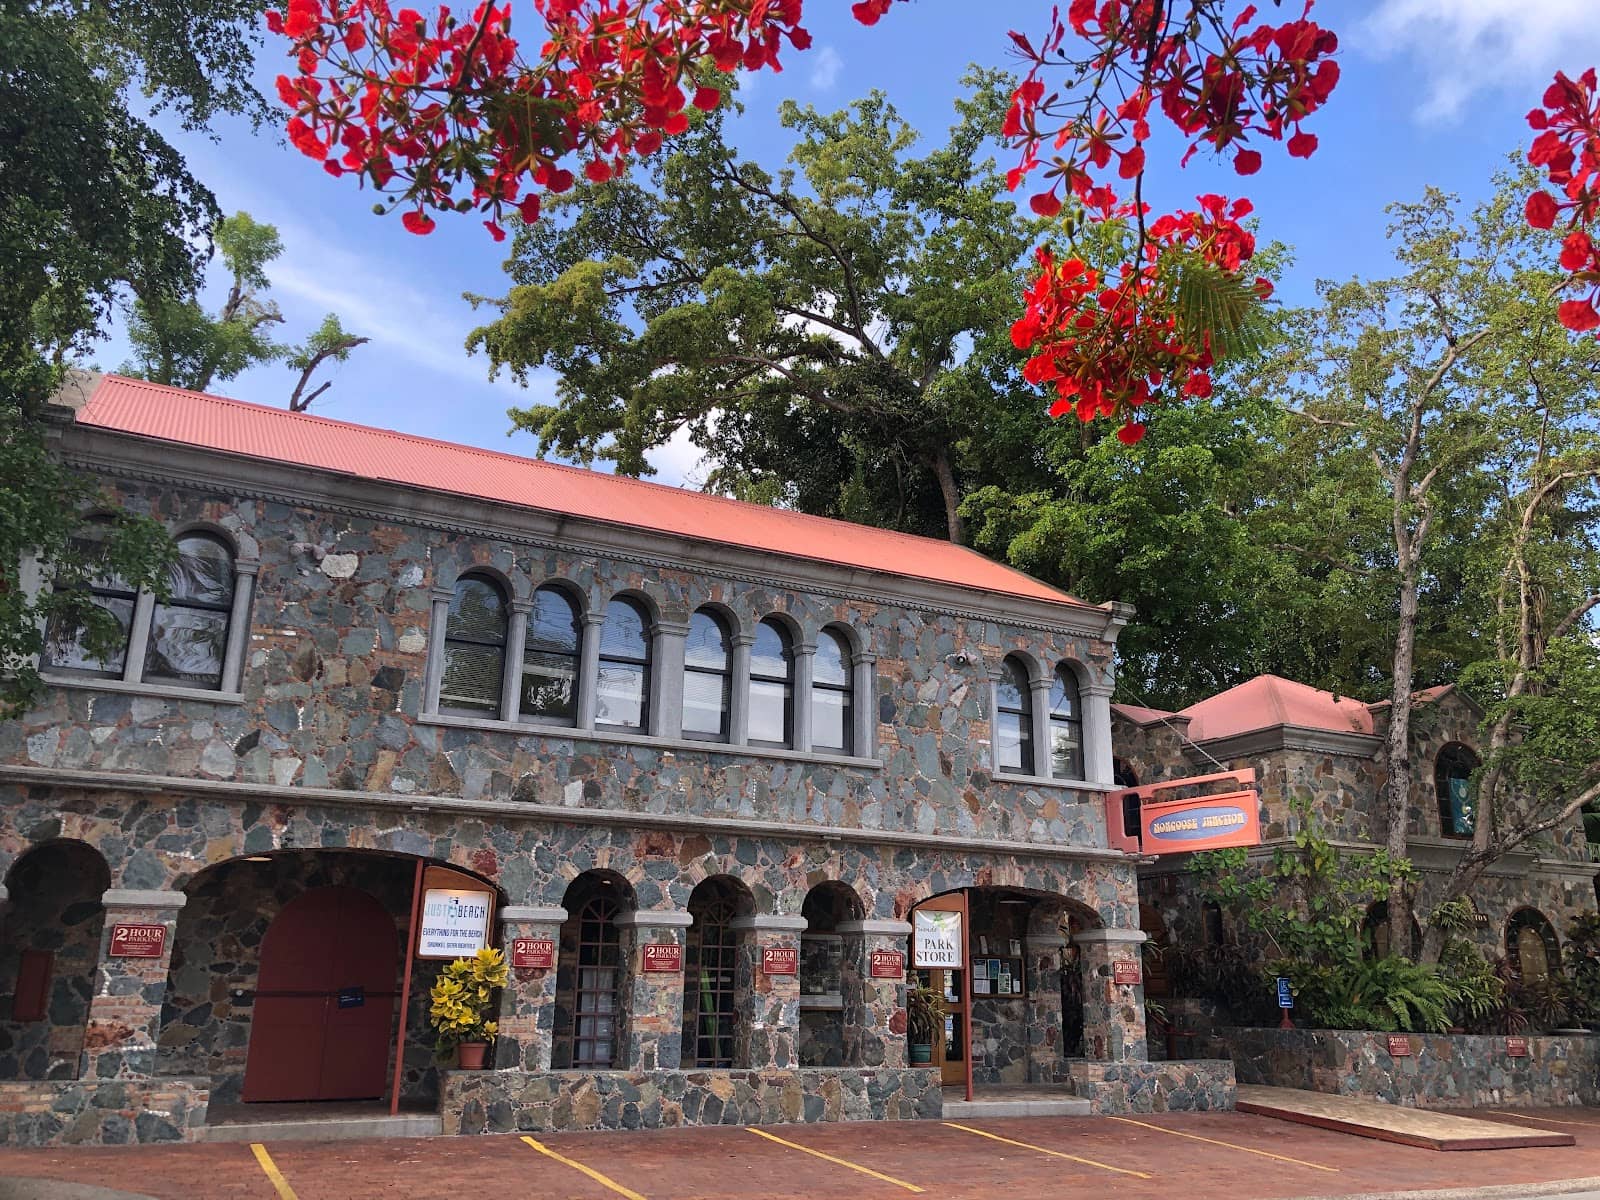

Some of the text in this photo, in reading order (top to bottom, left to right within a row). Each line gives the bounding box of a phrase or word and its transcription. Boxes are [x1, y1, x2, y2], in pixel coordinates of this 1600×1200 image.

[1153, 813, 1245, 834] MONGOOSE JUNCTION
[425, 904, 485, 919] JUST BEACH
[115, 927, 162, 941] 2 HOUR
[422, 928, 450, 937] EVERYTHING
[450, 929, 459, 937] FOR
[460, 930, 468, 938] THE
[516, 941, 552, 954] 2 HOUR
[924, 938, 953, 950] PARK
[647, 946, 679, 958] 2 HOUR
[765, 950, 795, 962] 2 HOUR
[916, 950, 955, 963] STORE
[873, 954, 901, 966] 2 HOUR
[1116, 963, 1123, 974] 2
